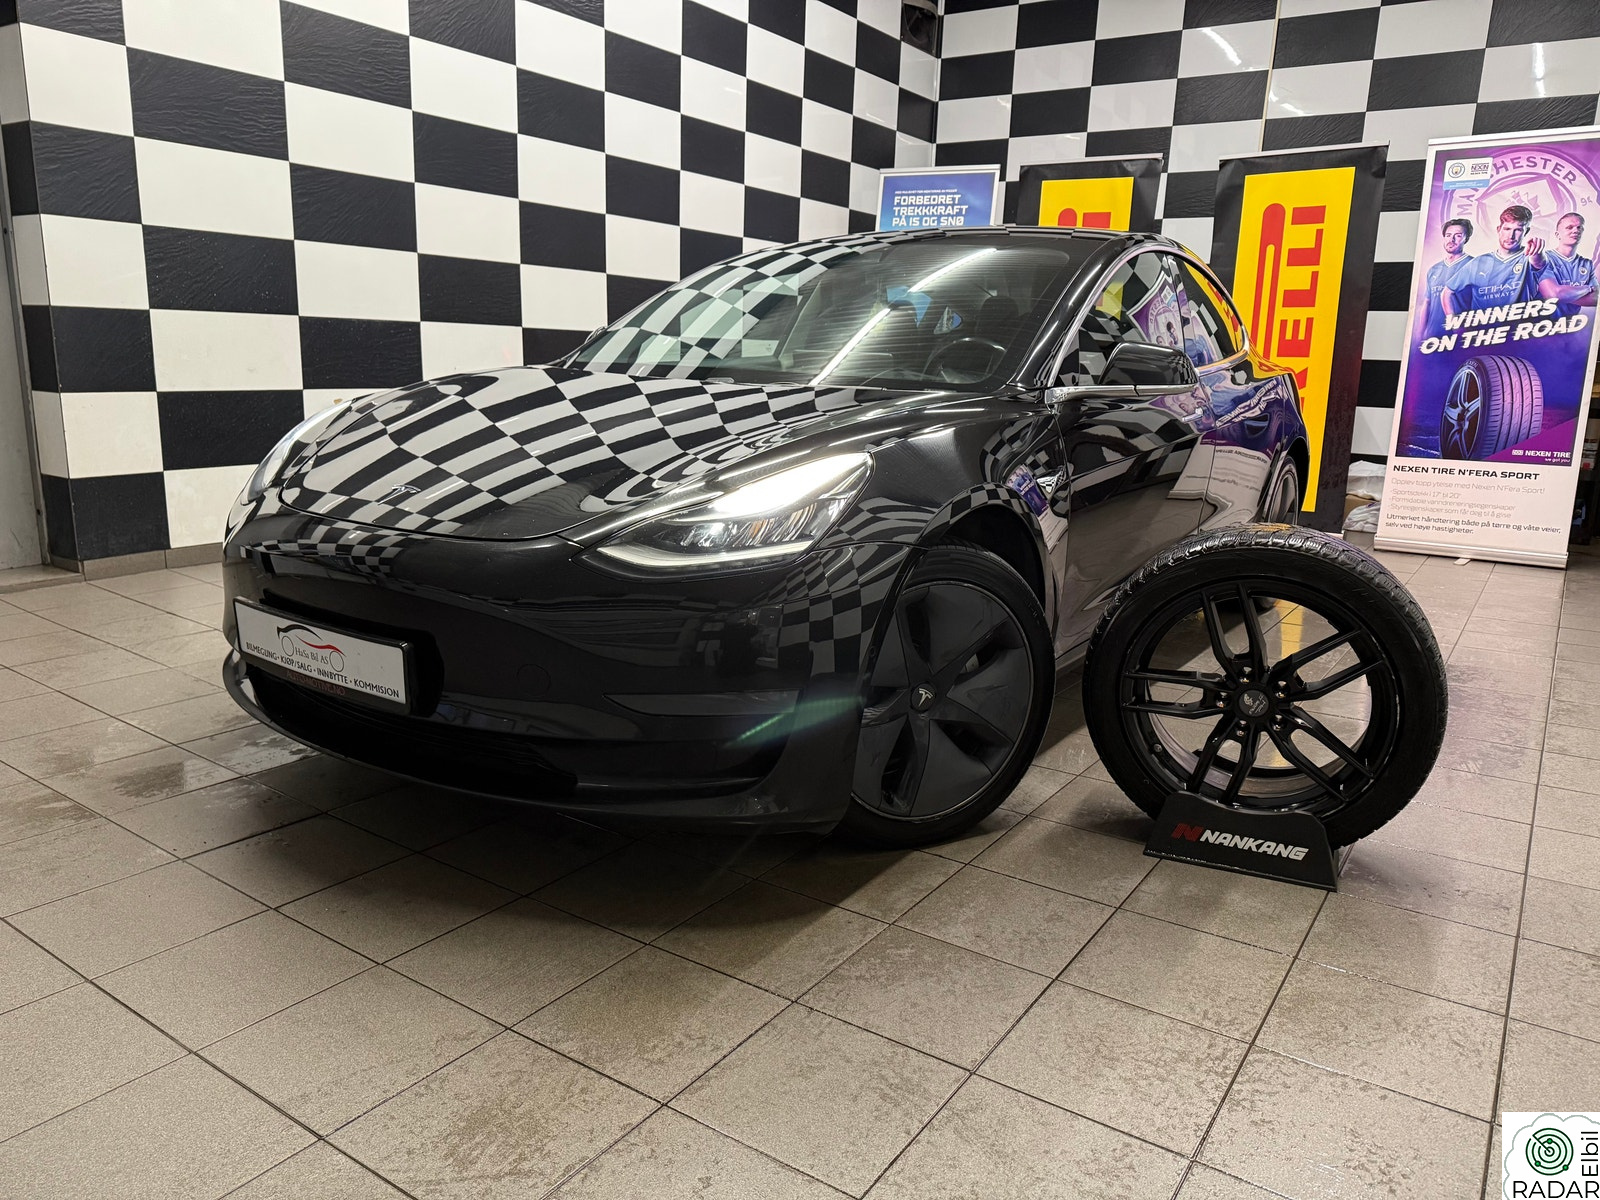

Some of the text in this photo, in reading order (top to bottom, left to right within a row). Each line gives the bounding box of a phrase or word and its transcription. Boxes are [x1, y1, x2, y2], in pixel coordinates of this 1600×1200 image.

[894, 194, 962, 206] FORBEDRET
[892, 205, 968, 216] TREKKKRAFT
[892, 215, 965, 226] PÅ IS OG SNØ
[1443, 298, 1559, 331] WINNERS
[1419, 314, 1588, 355] ON THE ROAD
[1525, 450, 1552, 458] NEXEN
[1393, 465, 1540, 480] NEXEN TIRE N'FERA SPORT
[1422, 516, 1460, 526] håndtering
[1432, 526, 1474, 534] hastigheter.
[320, 654, 329, 664] AS
[317, 668, 348, 684] INNBYTTE
[354, 678, 399, 698] KOMMISJON
[1200, 830, 1309, 861] NANKANG
